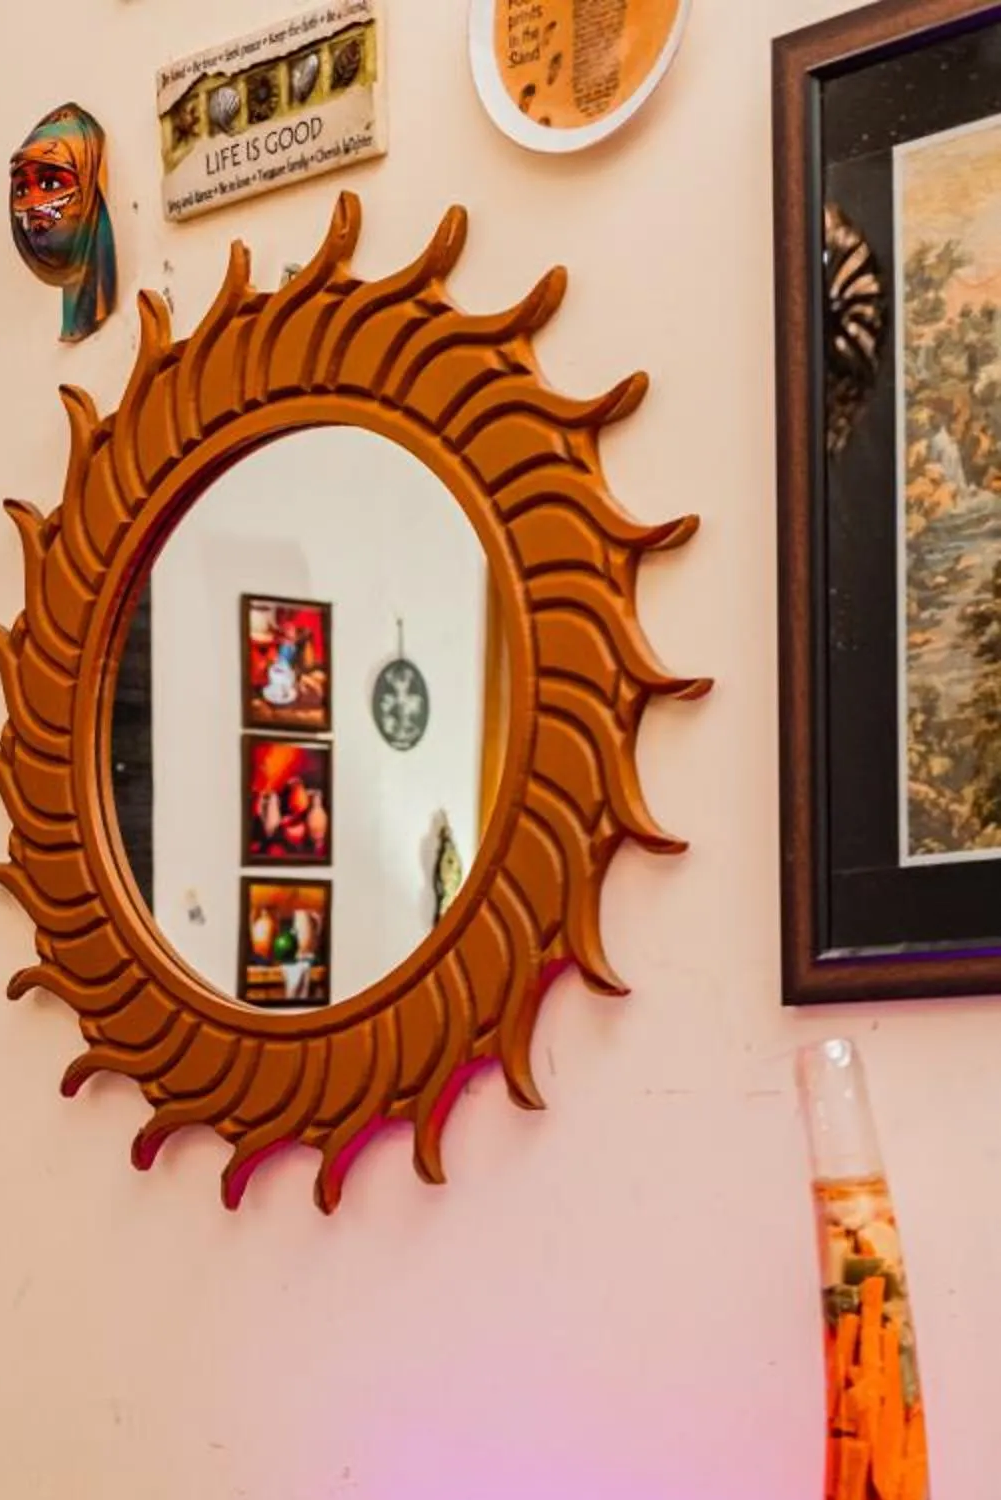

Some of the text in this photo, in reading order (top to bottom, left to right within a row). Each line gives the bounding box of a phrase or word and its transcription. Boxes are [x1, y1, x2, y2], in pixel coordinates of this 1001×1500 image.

[507, 43, 541, 69] Sand
[206, 117, 324, 175] LIFE IS GOOD
